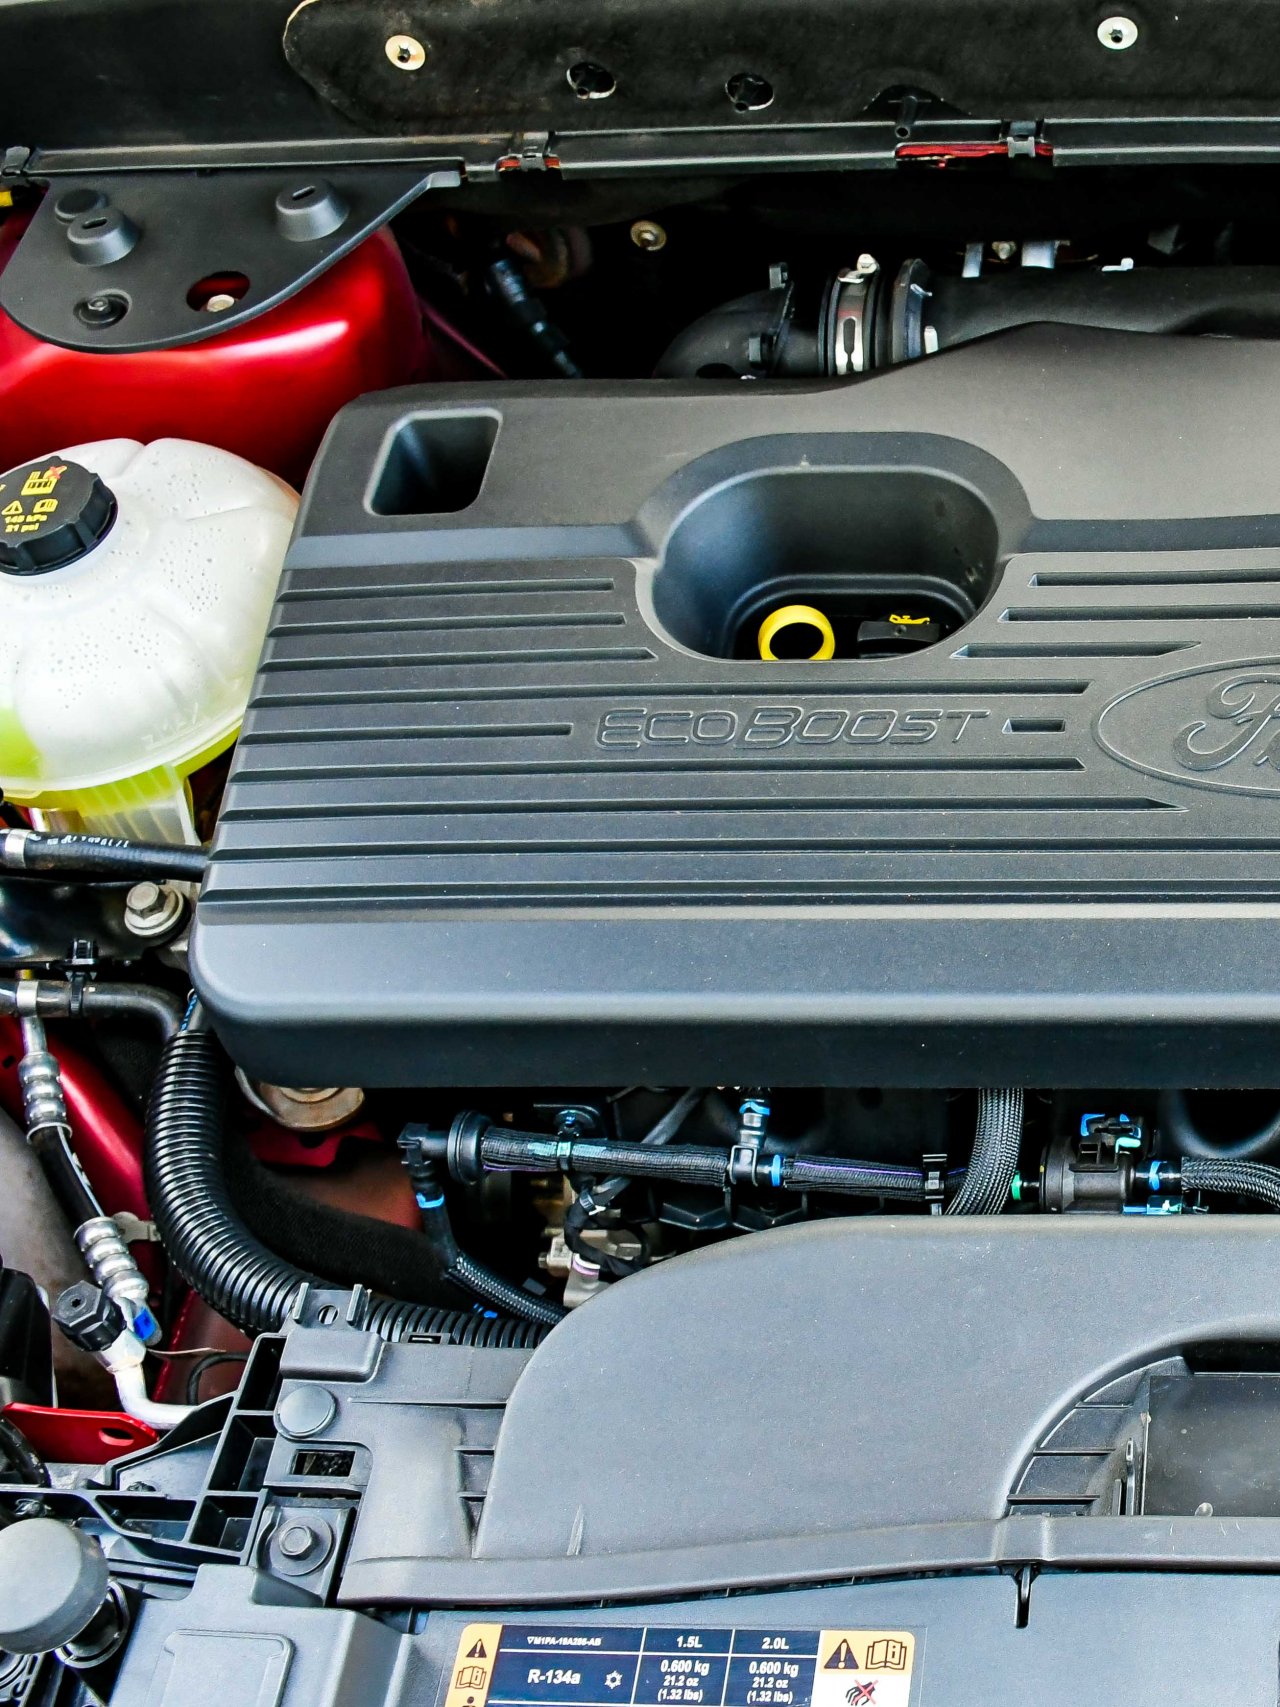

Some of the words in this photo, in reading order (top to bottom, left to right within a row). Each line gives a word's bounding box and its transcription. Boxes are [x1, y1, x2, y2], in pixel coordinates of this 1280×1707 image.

[26, 514, 47, 522] kPa
[20, 523, 40, 533] psi
[676, 1636, 703, 1648] 1.5L
[762, 1637, 789, 1649] 2.0L
[660, 1659, 693, 1673] 0.600
[694, 1660, 710, 1676] kg
[748, 1661, 781, 1675] 0.600
[783, 1662, 799, 1677] kg
[527, 1669, 581, 1685] R-134a
[663, 1676, 684, 1687] 21.2
[686, 1678, 699, 1687] oz
[752, 1677, 774, 1688] 21.2
[775, 1679, 788, 1689] oz
[657, 1688, 682, 1702] (1.32
[684, 1690, 703, 1702] lbs)
[746, 1690, 772, 1703] (1.32
[773, 1691, 793, 1704] lbs)
